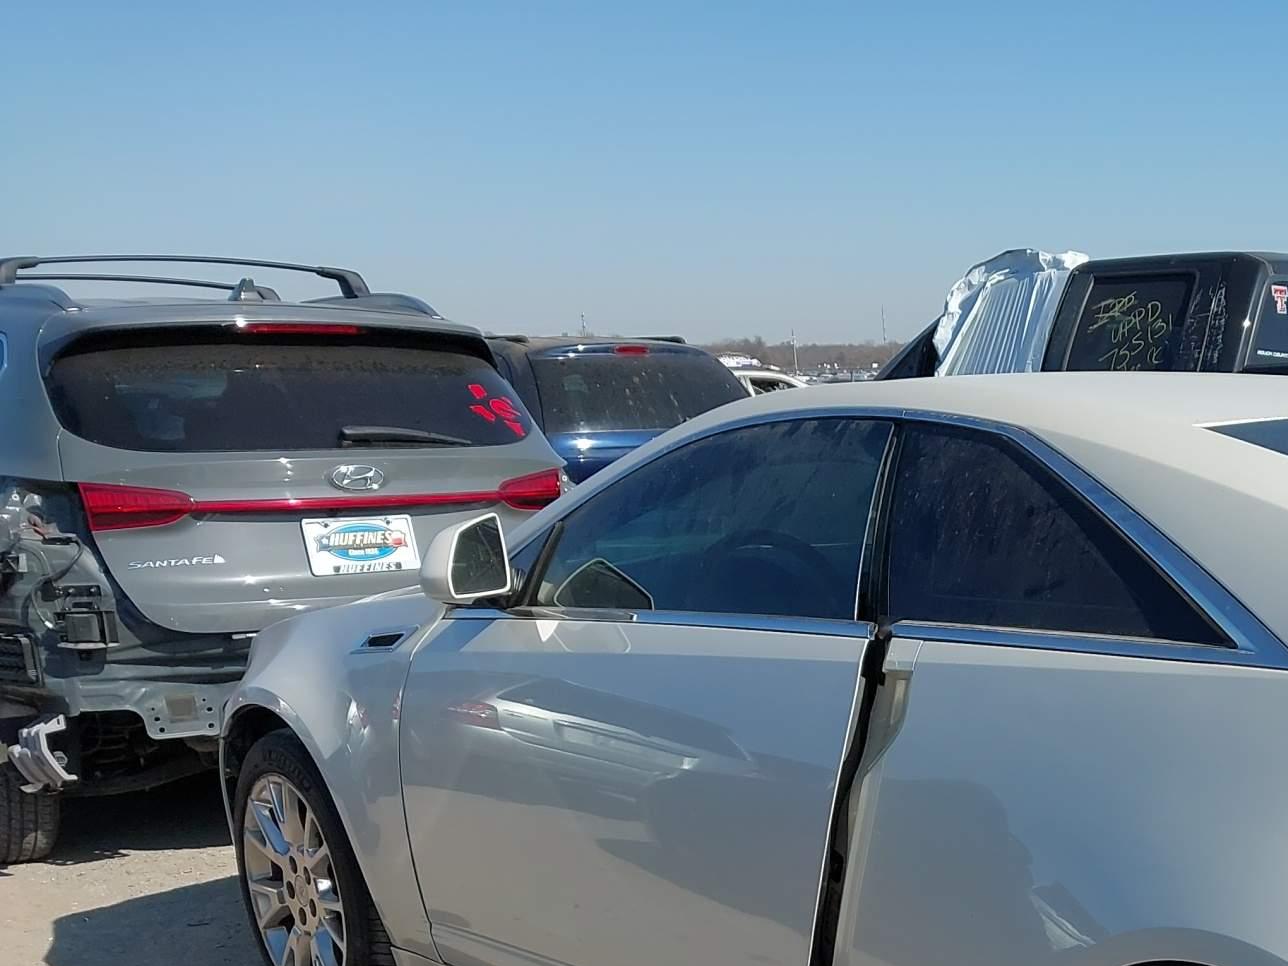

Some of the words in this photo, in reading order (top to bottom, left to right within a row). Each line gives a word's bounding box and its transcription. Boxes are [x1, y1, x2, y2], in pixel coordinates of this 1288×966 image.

[329, 531, 392, 546] HUFFINES
[128, 559, 190, 570] SANTA
[192, 556, 214, 565] FE
[340, 562, 397, 573] HUFFINES
